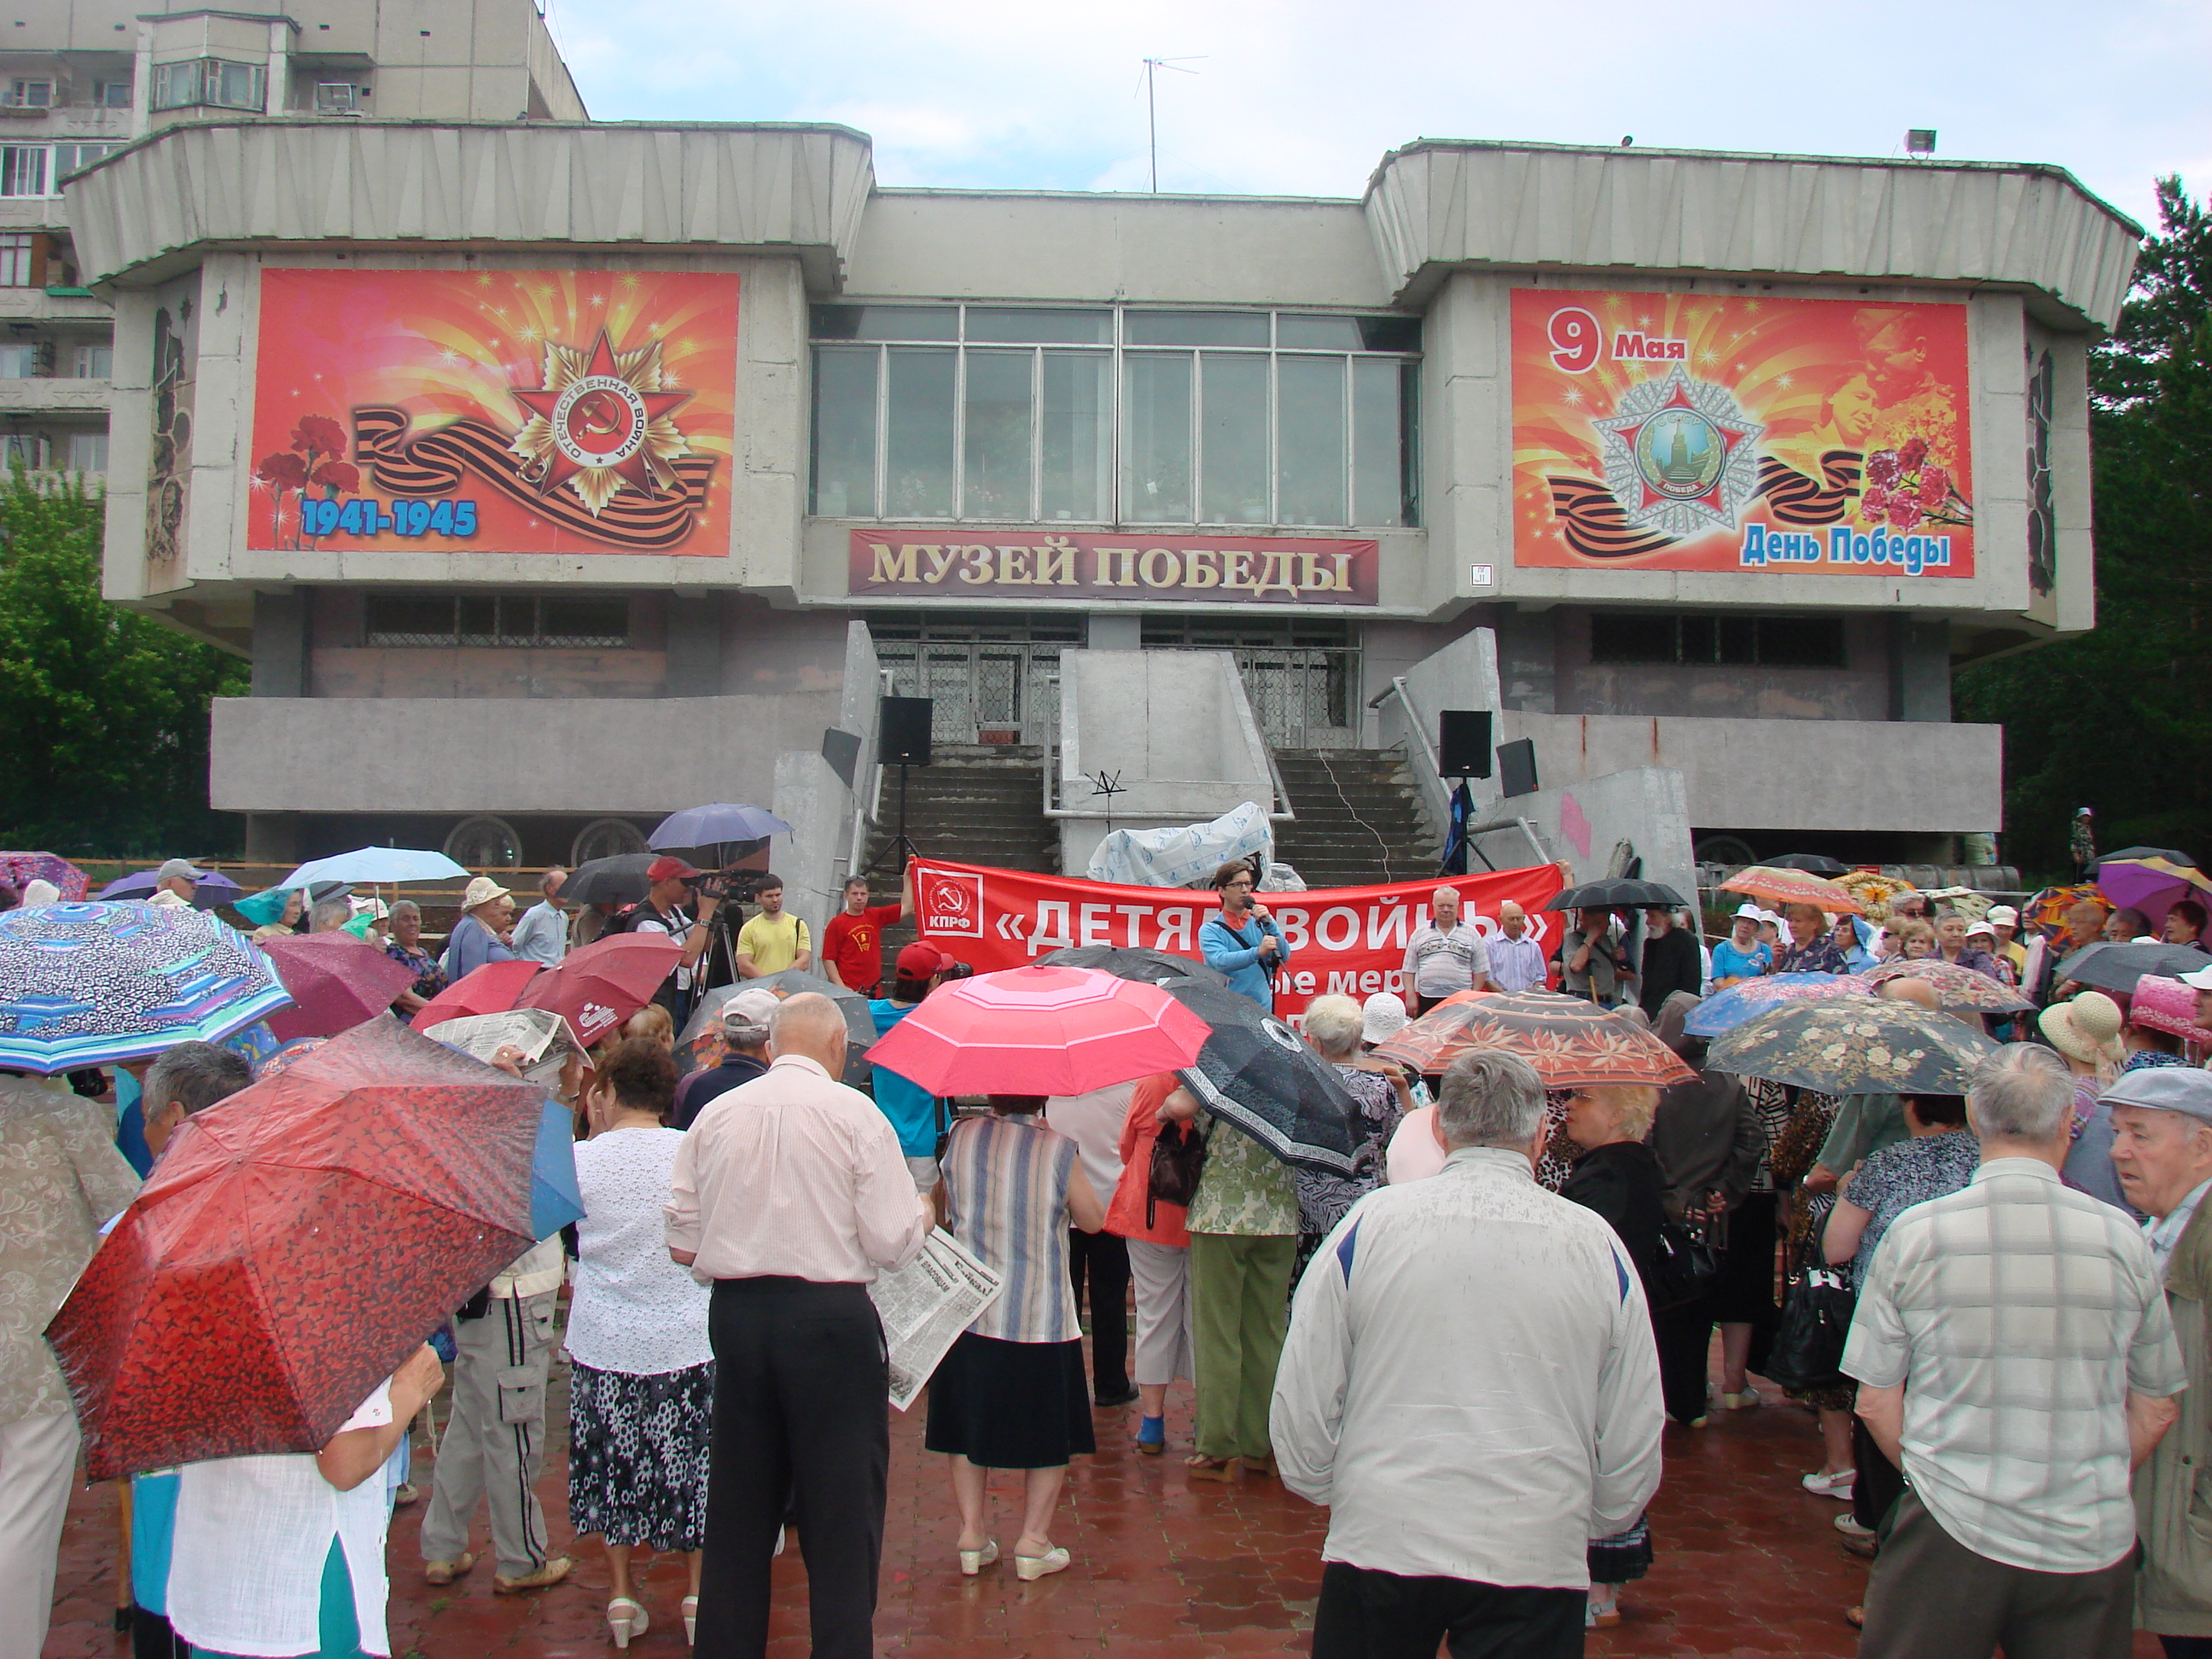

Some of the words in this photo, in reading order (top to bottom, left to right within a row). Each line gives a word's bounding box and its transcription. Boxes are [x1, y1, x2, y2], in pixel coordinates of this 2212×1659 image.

[1547, 307, 1602, 375] 9
[1611, 331, 1688, 362] Мая
[556, 378, 638, 459] ОТЕЧЕСТВЕННАЯ
[1656, 413, 1702, 427] СССР
[1662, 483, 1700, 494] ПОБЕДА
[302, 499, 477, 537] 1941-1945
[868, 535, 1080, 586] МУЗЕЙ
[1092, 547, 1353, 599] ПОБЕДЫ
[1739, 523, 1821, 567] День
[1827, 524, 1951, 576] Победы
[929, 915, 971, 929] КПРФ
